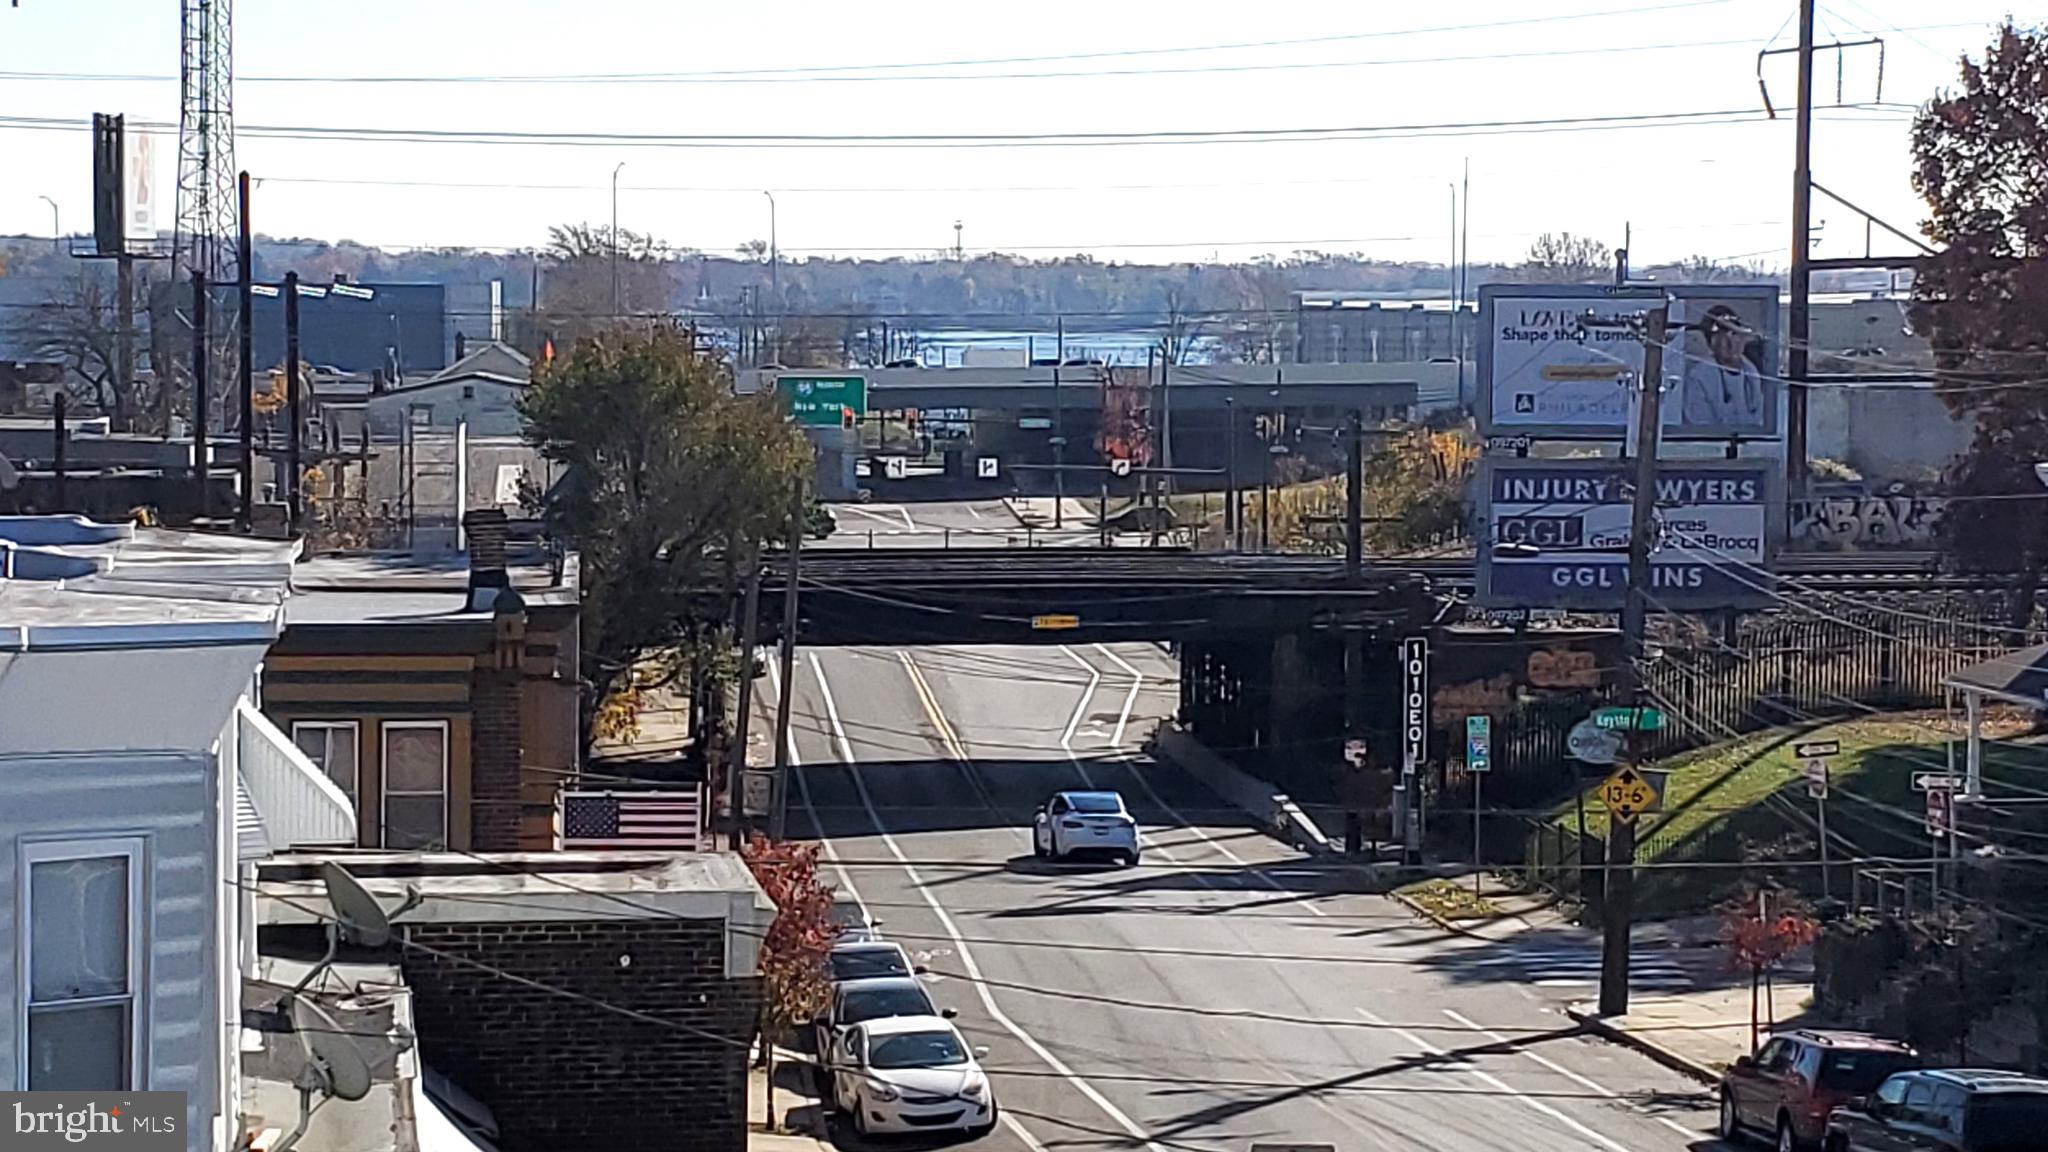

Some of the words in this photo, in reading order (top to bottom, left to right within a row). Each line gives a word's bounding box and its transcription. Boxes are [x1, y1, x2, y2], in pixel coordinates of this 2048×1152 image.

[1502, 327, 1548, 345] Shape
[1503, 479, 1608, 500] INJURY
[1503, 519, 1579, 545] GGL
[1552, 567, 1612, 587] GGL
